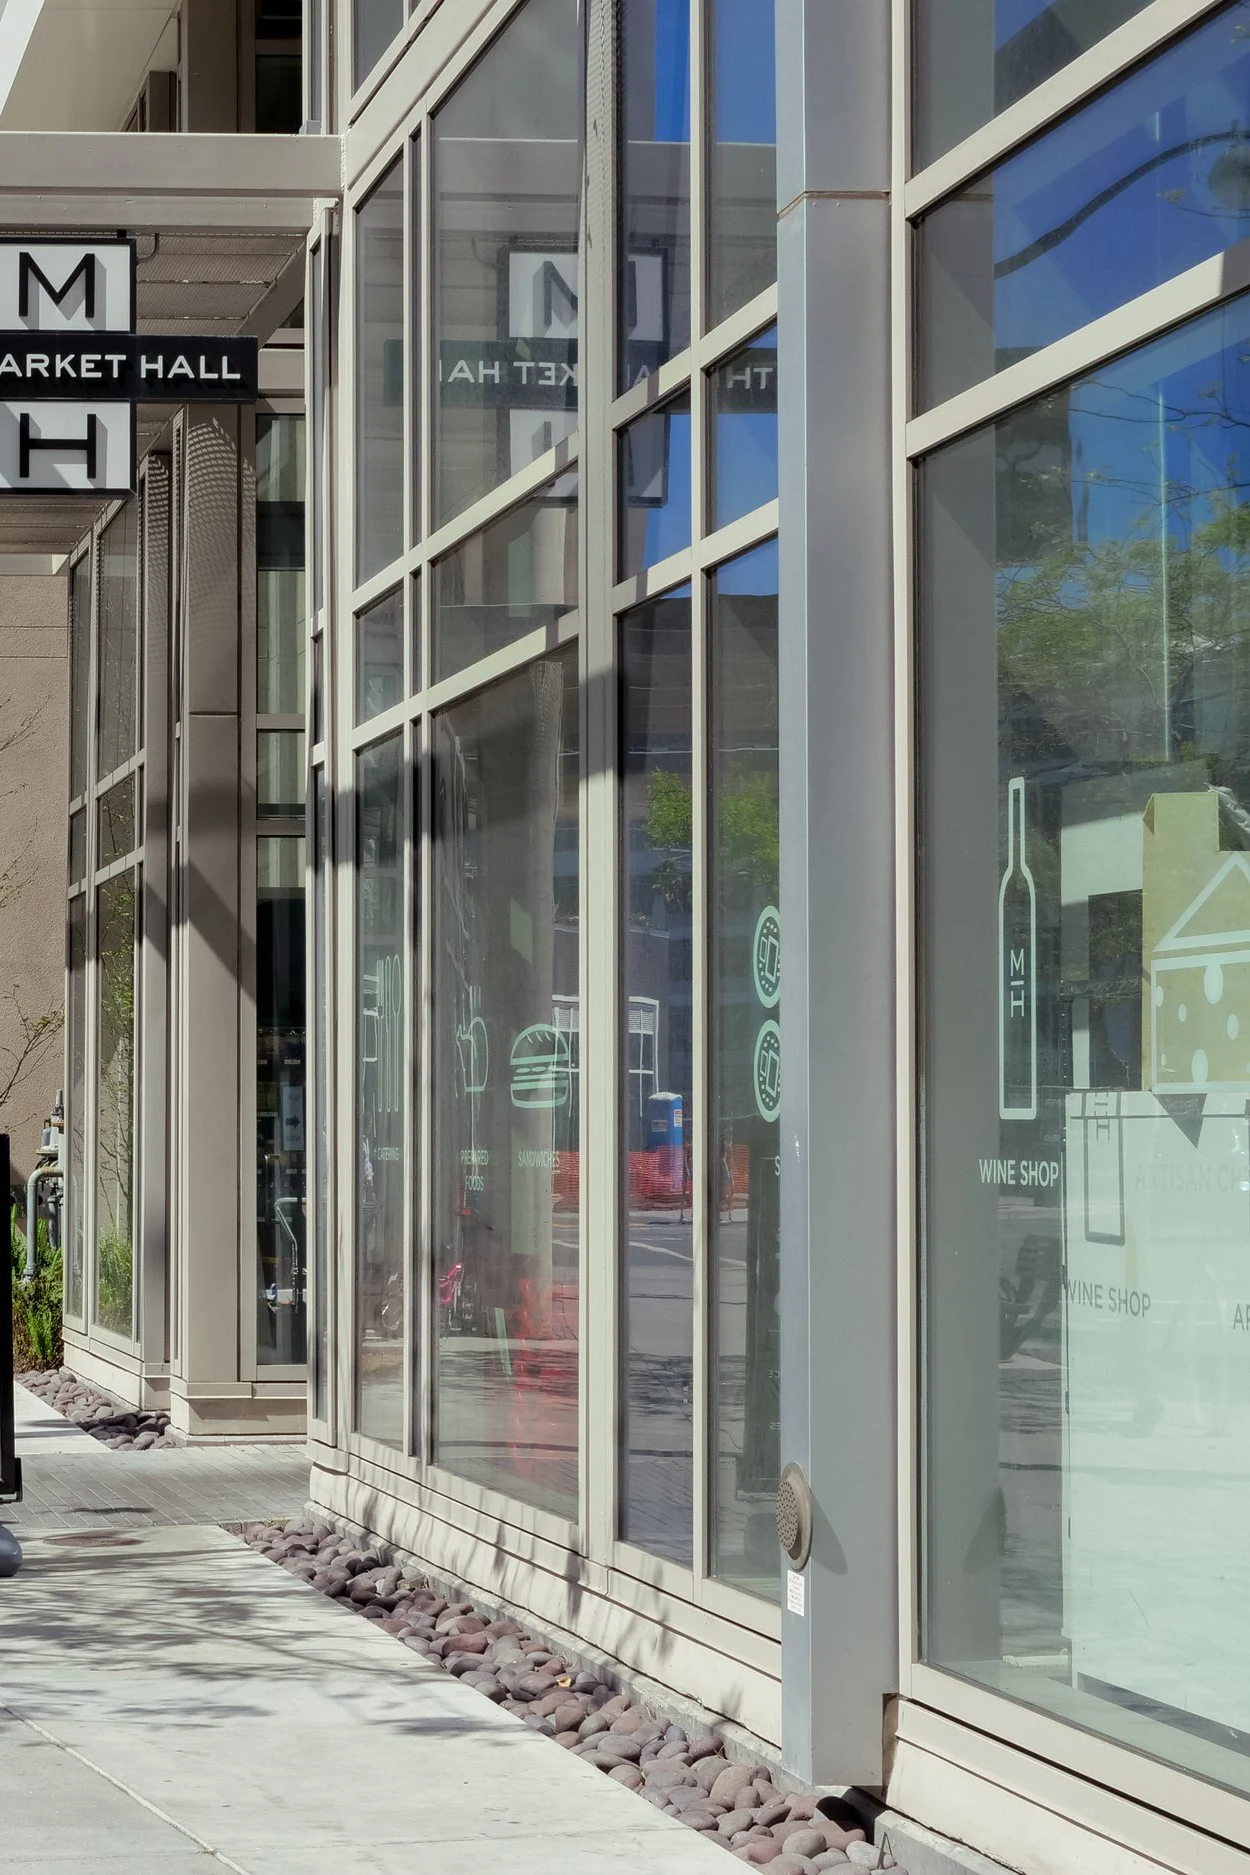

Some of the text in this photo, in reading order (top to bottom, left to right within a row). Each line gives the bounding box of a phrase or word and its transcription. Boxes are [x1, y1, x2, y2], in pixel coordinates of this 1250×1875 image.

[18, 251, 96, 318] M
[139, 354, 242, 380] HALL
[19, 412, 97, 479] H
[1010, 948, 1024, 977] M
[1010, 989, 1024, 1018] H
[460, 1150, 489, 1166] PREPARED
[518, 1150, 560, 1168] SANDWICHES
[979, 1158, 1059, 1187] WINE SHOP
[464, 1175, 484, 1191] FOODS
[1108, 1287, 1151, 1318] SHOP
